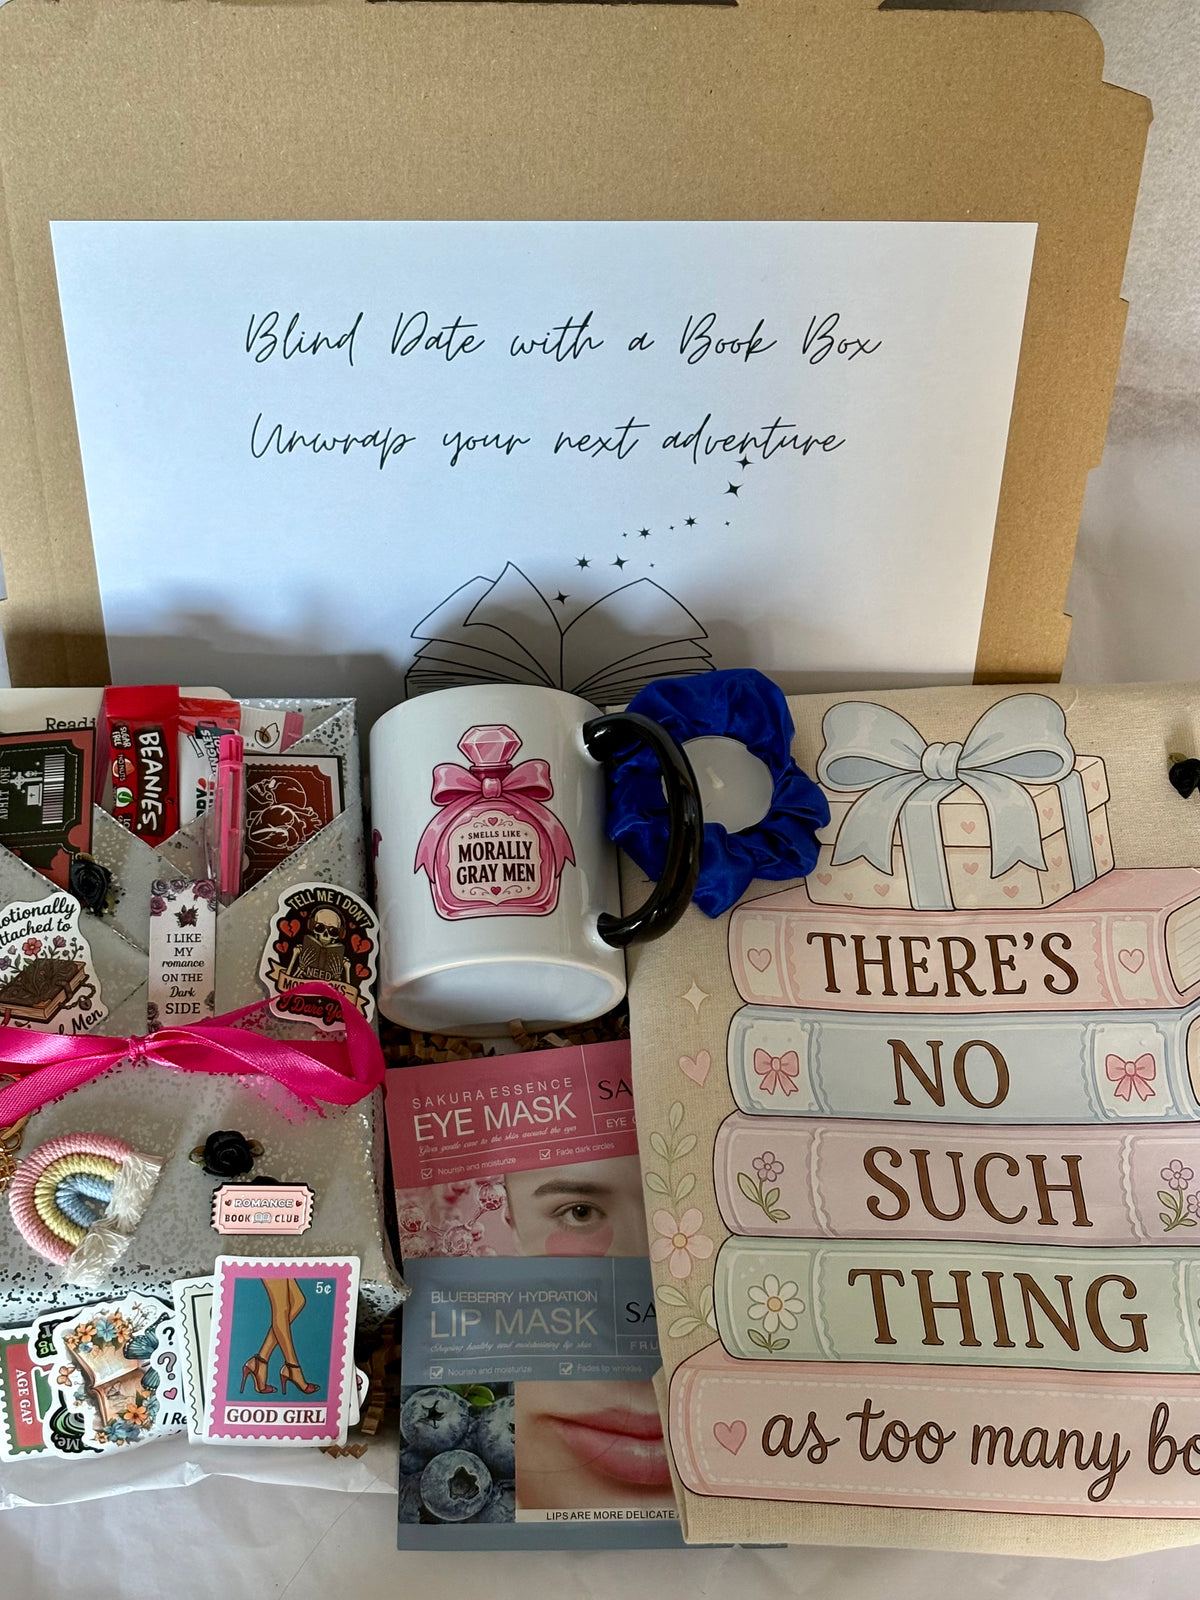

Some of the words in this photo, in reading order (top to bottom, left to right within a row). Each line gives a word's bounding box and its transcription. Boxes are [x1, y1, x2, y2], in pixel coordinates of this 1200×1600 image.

[246, 311, 363, 364] Blind
[391, 312, 484, 361] Date
[510, 311, 604, 361] with
[628, 332, 654, 353] a
[680, 313, 777, 364] Book
[802, 313, 882, 364] Box
[251, 413, 416, 469] Unwrap
[442, 431, 530, 466] your
[554, 416, 650, 459] next
[663, 413, 846, 465] adventure
[112, 731, 121, 747] FREE
[120, 726, 132, 748] SUGAR
[467, 831, 499, 840] SMELLS
[502, 830, 521, 838] LIKE
[458, 841, 533, 863] MORALLY
[456, 863, 498, 885] GRAY
[502, 863, 536, 882] MEN
[0, 897, 77, 929] otionally
[287, 892, 315, 910] TELL
[316, 890, 334, 903] ME
[336, 892, 341, 905] I
[341, 898, 372, 928] DON'T
[0, 917, 54, 949] ttached
[57, 918, 72, 932] to
[167, 934, 171, 943] I
[174, 933, 202, 943] LIKE
[174, 947, 194, 957] MY
[161, 960, 205, 968] romance
[306, 966, 332, 980] NEED
[806, 931, 1080, 998] THERE'S
[161, 973, 179, 982] ON
[181, 973, 203, 982] THE
[169, 986, 196, 997] Dark
[165, 1002, 201, 1014] SIDE
[291, 996, 324, 1015] Dare
[325, 1002, 343, 1023] Yo
[71, 1009, 103, 1036] Men
[886, 1038, 1011, 1110] NO
[412, 1089, 485, 1110] SAKURA
[489, 1076, 574, 1099] ESSENCE
[598, 1078, 634, 1100] SA
[413, 1107, 475, 1142] EYE
[483, 1092, 577, 1132] MASK
[606, 1116, 627, 1128] EYE
[491, 1134, 502, 1143] the
[505, 1132, 519, 1141] skin
[522, 1127, 548, 1138] around
[550, 1127, 561, 1135] the
[564, 1125, 577, 1136] eyes
[556, 1148, 574, 1157] Fade
[575, 1144, 592, 1154] dark
[592, 1142, 615, 1151] circles
[438, 1165, 465, 1176] Nourish
[467, 1162, 480, 1171] and
[862, 1145, 1094, 1228] SUCH
[234, 1198, 294, 1208] ROMANCE
[224, 1214, 251, 1223] BOOK
[274, 1214, 300, 1223] CLUB
[431, 1291, 513, 1304] BLUEBERRY
[519, 1290, 598, 1303] HYDRATION
[625, 1301, 657, 1323] SA
[847, 1267, 1150, 1354] THING
[430, 1308, 481, 1339] LIP
[495, 1307, 598, 1336] MASK
[630, 1340, 658, 1351] FRU
[448, 1367, 477, 1377] Nourish
[479, 1366, 492, 1375] and
[15, 1369, 29, 1397] AGE
[19, 1397, 33, 1426] GAP
[162, 1412, 168, 1425] I
[171, 1412, 188, 1425] Re
[226, 1408, 278, 1425] GOOD
[283, 1408, 327, 1425] GIRL
[761, 1411, 840, 1465] as
[845, 1398, 956, 1464] too
[970, 1422, 1131, 1503] many
[1147, 1402, 1200, 1476] bo
[546, 1511, 569, 1521] LIPS
[570, 1511, 591, 1520] ARE
[593, 1510, 624, 1520] MORE
[626, 1509, 676, 1520] DELICATE
